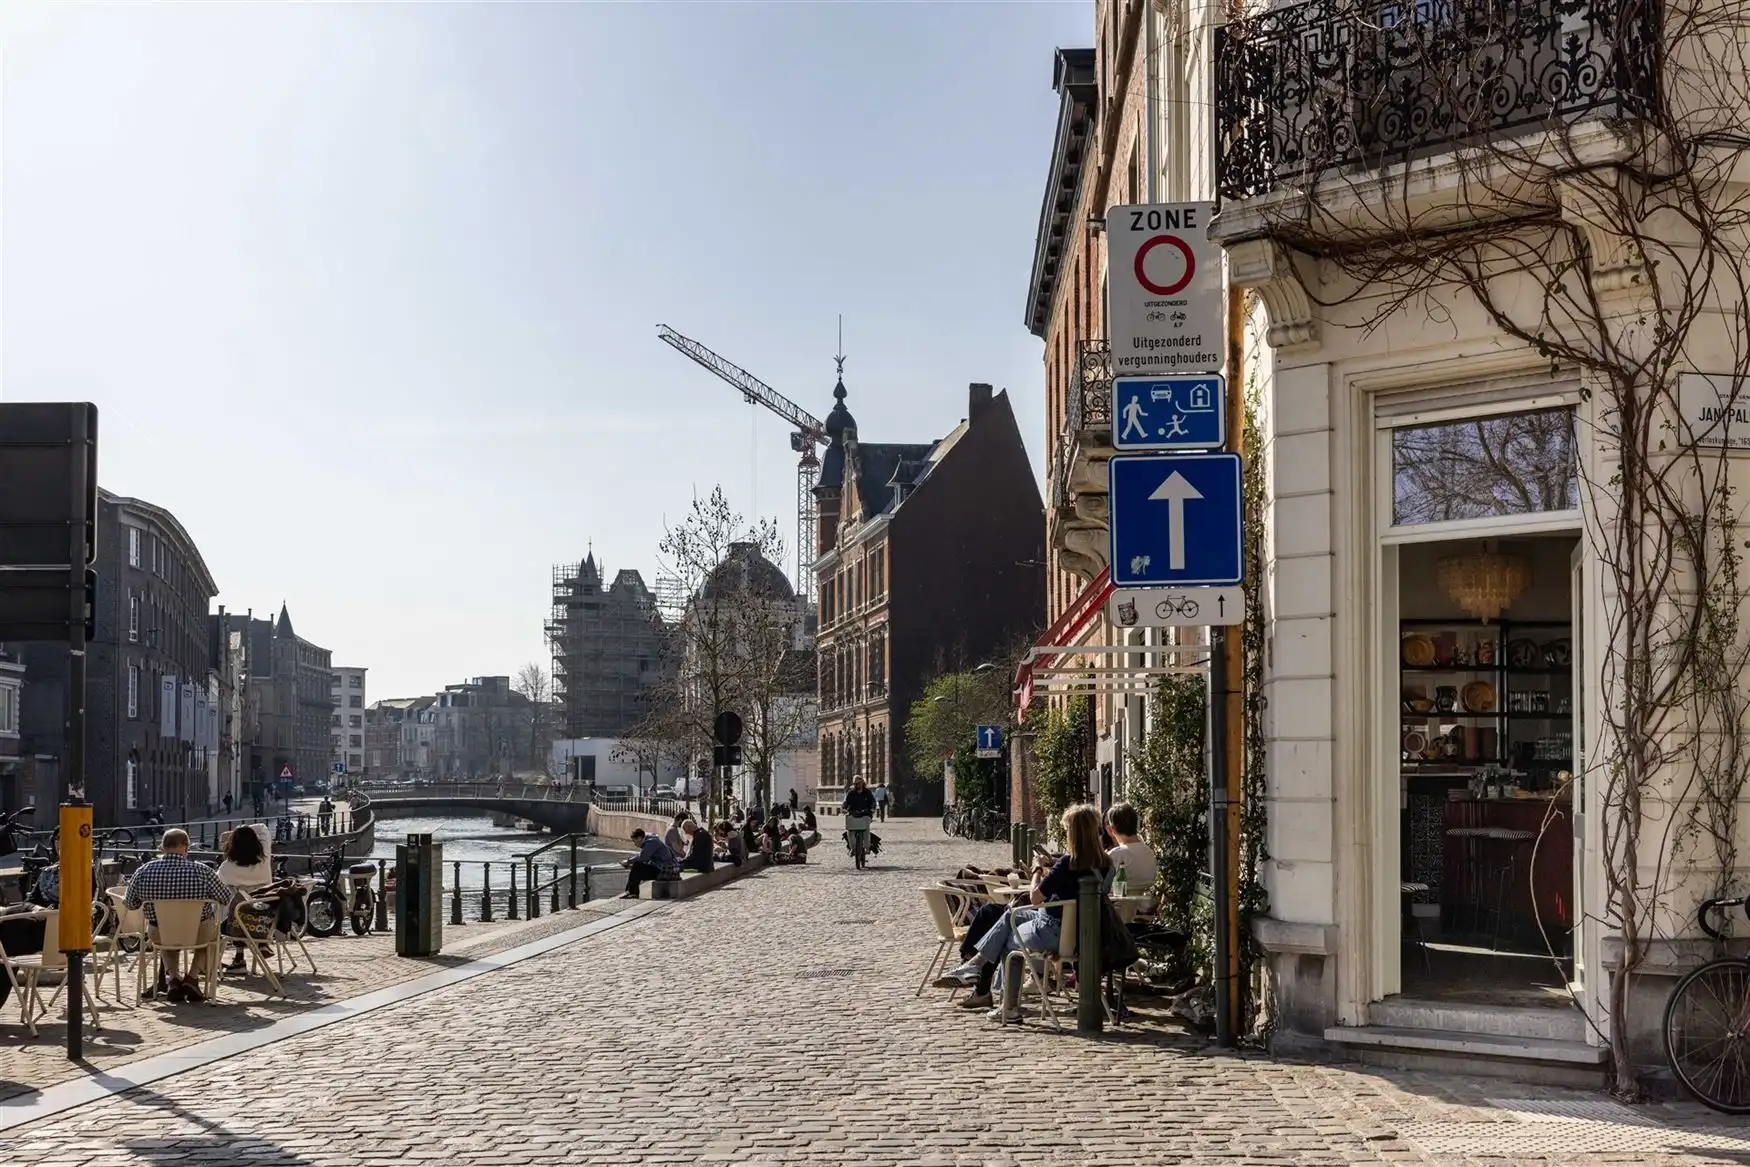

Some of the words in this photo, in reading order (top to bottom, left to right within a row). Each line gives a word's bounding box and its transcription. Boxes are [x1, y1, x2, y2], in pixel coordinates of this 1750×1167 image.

[1130, 208, 1197, 231] ZONE
[1144, 299, 1188, 307] UITGEZONDERD
[1133, 334, 1202, 351] Uitgezonderd
[1118, 352, 1218, 369] vergunninghouders
[1698, 407, 1721, 422] JAN
[1728, 408, 1750, 423] PAL
